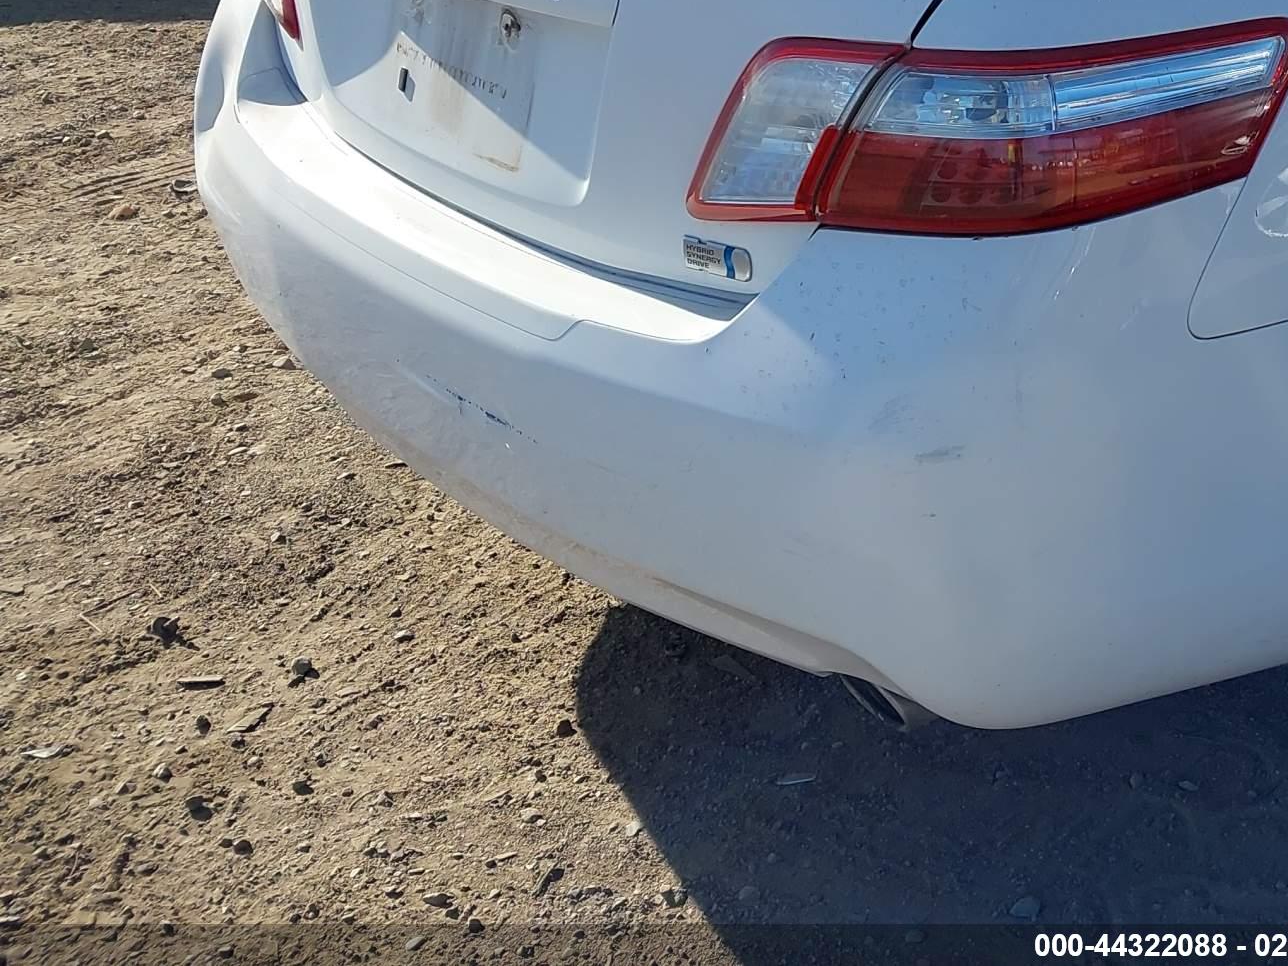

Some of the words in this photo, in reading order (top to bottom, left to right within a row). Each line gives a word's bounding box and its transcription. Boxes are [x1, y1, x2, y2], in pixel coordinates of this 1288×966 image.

[686, 244, 715, 256] HYBRID
[686, 251, 721, 265] SYNERGY
[687, 258, 710, 269] DRIVE
